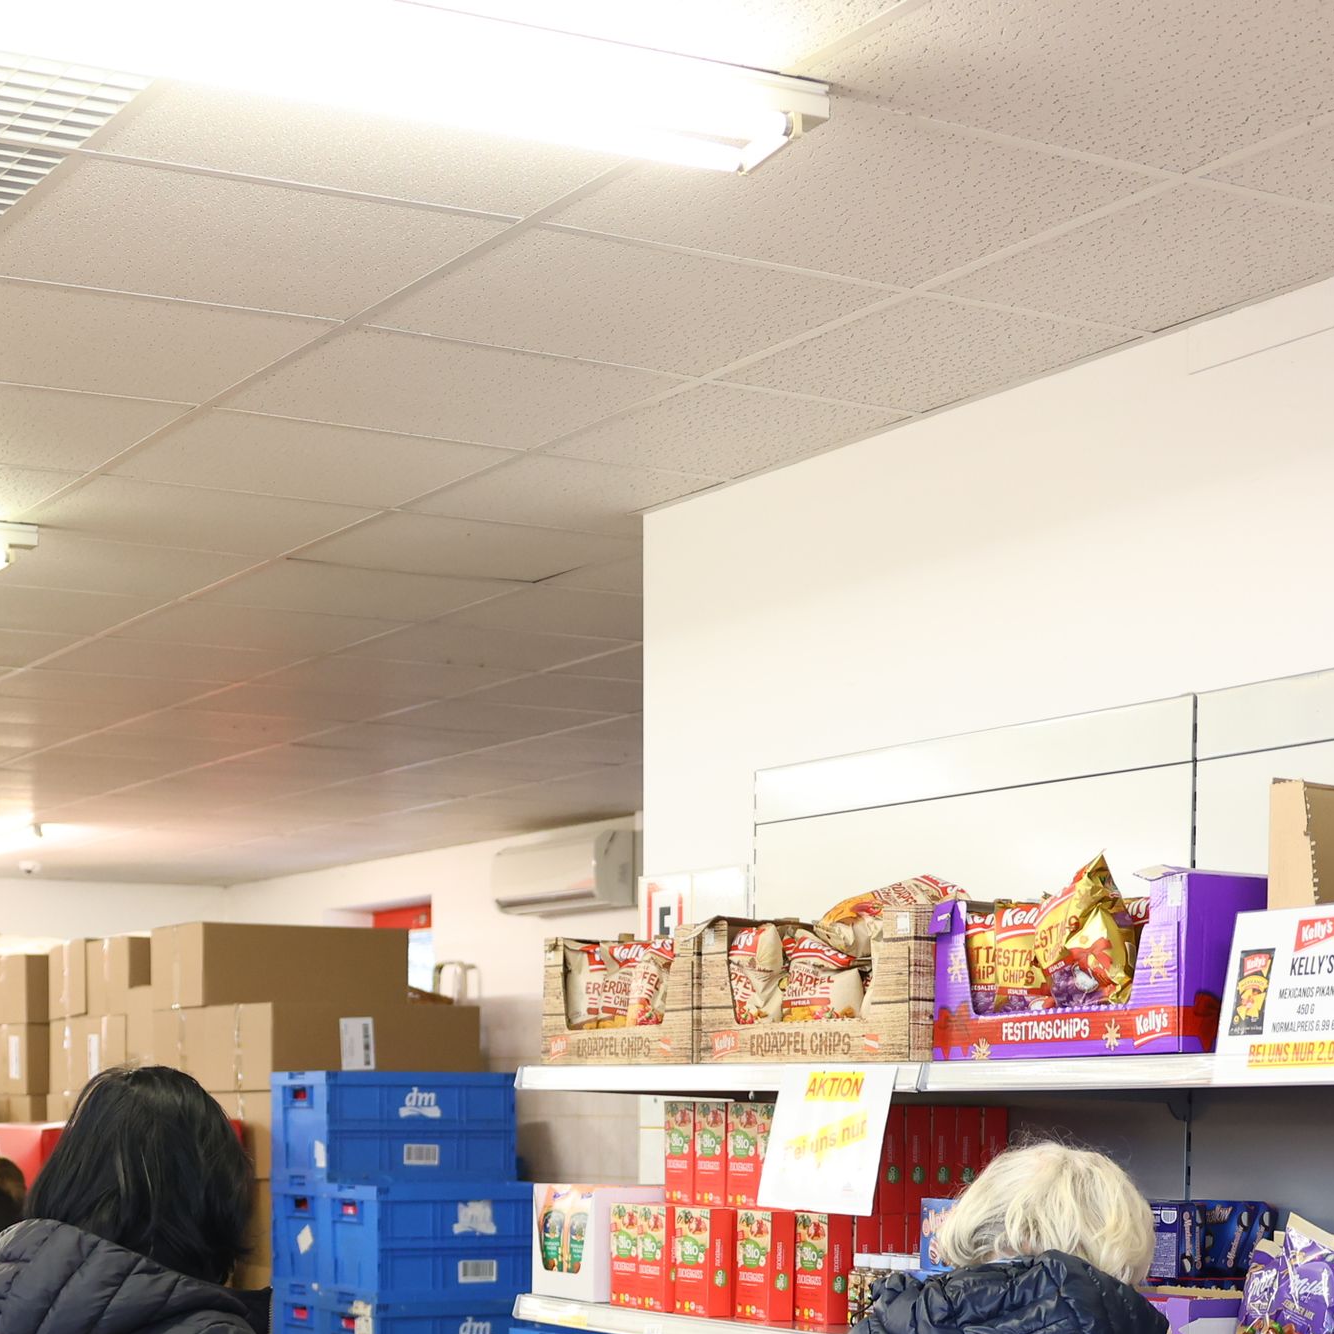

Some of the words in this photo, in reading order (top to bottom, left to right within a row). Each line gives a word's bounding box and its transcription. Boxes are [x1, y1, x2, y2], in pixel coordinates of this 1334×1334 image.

[1301, 920, 1334, 941] Kelly's
[1278, 986, 1315, 1000] MEXICANOS
[1296, 1003, 1310, 1015] 450
[1134, 1008, 1168, 1035] Kelly's
[1271, 1021, 1314, 1033] NORMALPREIS
[576, 1037, 618, 1057] ERDÄPFEL
[749, 1032, 807, 1056] ERDÄPFEL
[1248, 1044, 1265, 1063] BEI
[1267, 1043, 1290, 1063] UNS
[1291, 1042, 1315, 1062] NUR
[405, 1087, 436, 1107] dm
[805, 1078, 865, 1097] AKTION
[810, 1132, 837, 1154] uns
[841, 1118, 867, 1139] nur
